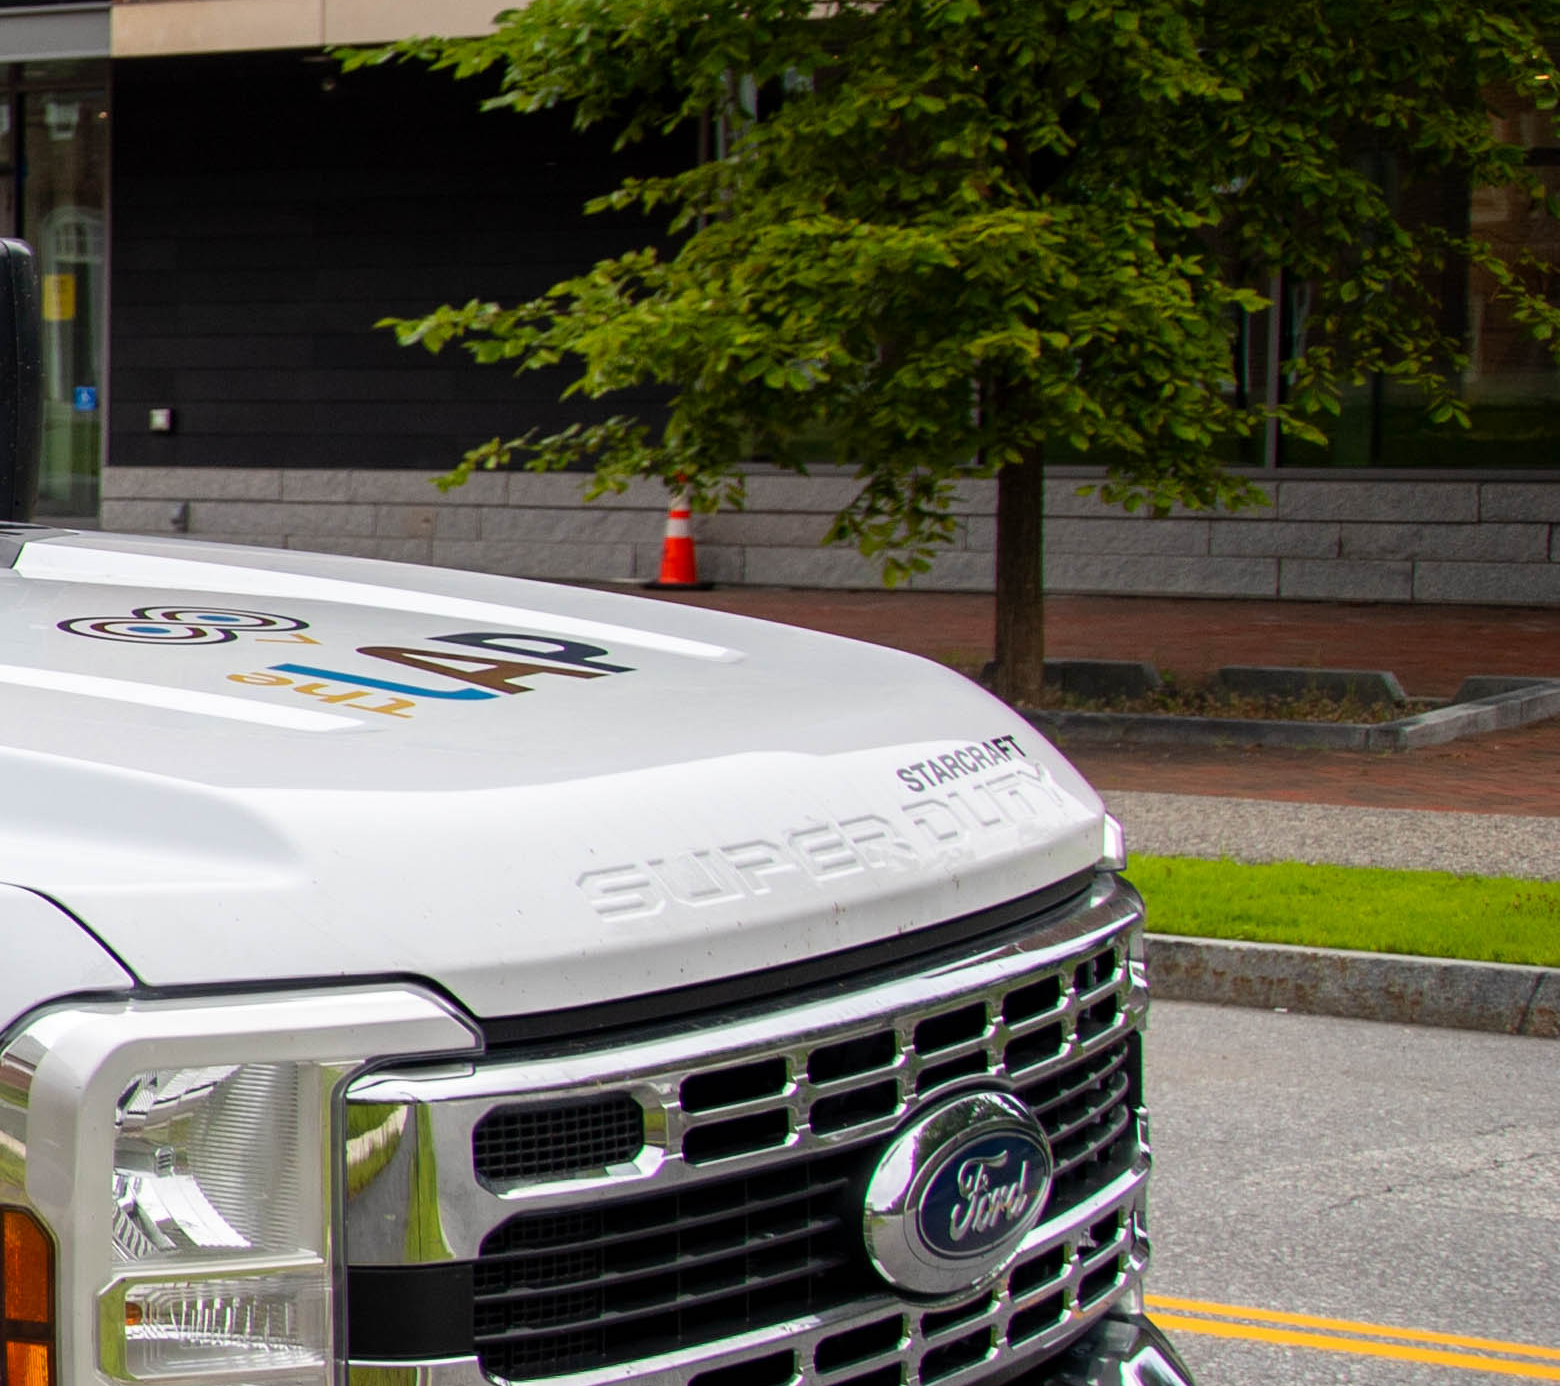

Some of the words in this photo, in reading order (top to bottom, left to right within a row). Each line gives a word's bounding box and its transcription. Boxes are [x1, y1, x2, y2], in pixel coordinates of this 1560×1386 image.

[267, 632, 638, 701] LAP
[896, 734, 1027, 793] STARCRAFT
[574, 813, 918, 924] SUPER
[902, 761, 1066, 841] DUTY
[950, 1150, 1030, 1241] Ford
